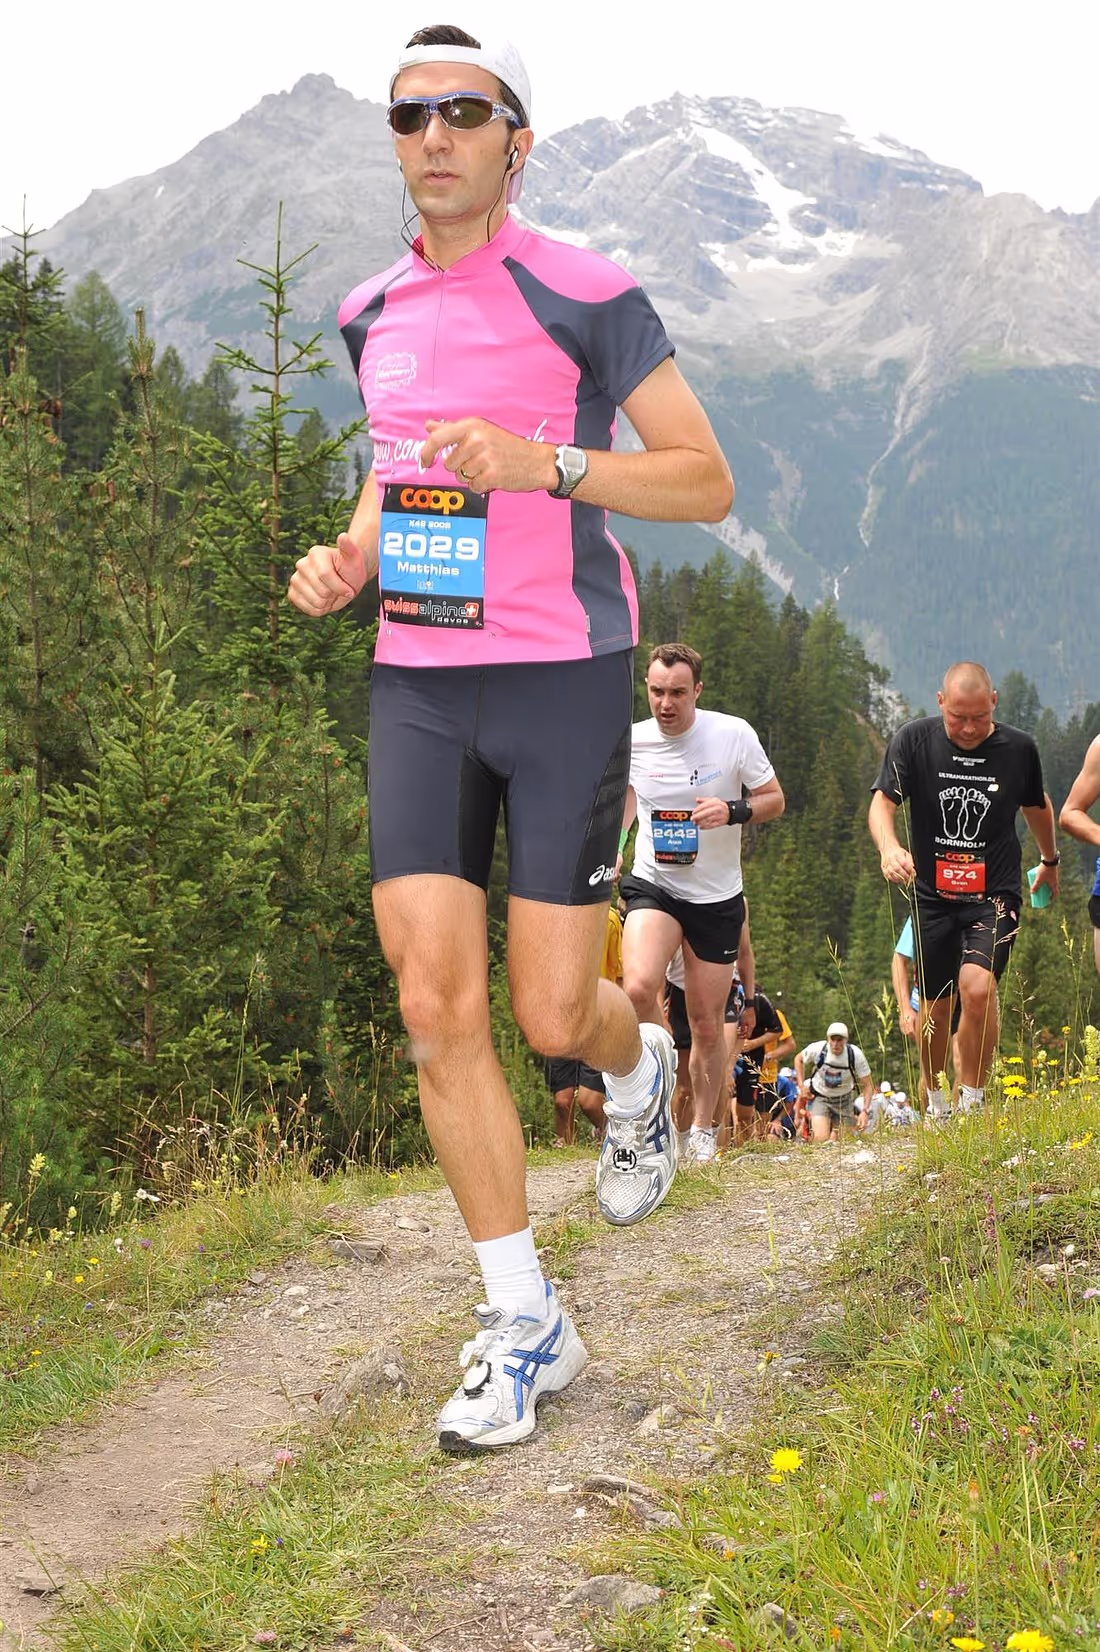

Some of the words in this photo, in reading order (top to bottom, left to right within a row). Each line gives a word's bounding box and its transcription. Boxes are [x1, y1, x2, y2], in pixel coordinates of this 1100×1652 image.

[400, 487, 465, 515] coop
[383, 531, 480, 561] 2029
[397, 561, 460, 576] Matthias
[437, 616, 469, 624] davos
[659, 811, 689, 821] coop
[653, 828, 697, 839] 2442
[934, 836, 986, 848] BORNHOLM
[945, 852, 975, 863] coop
[943, 868, 977, 880] 974
